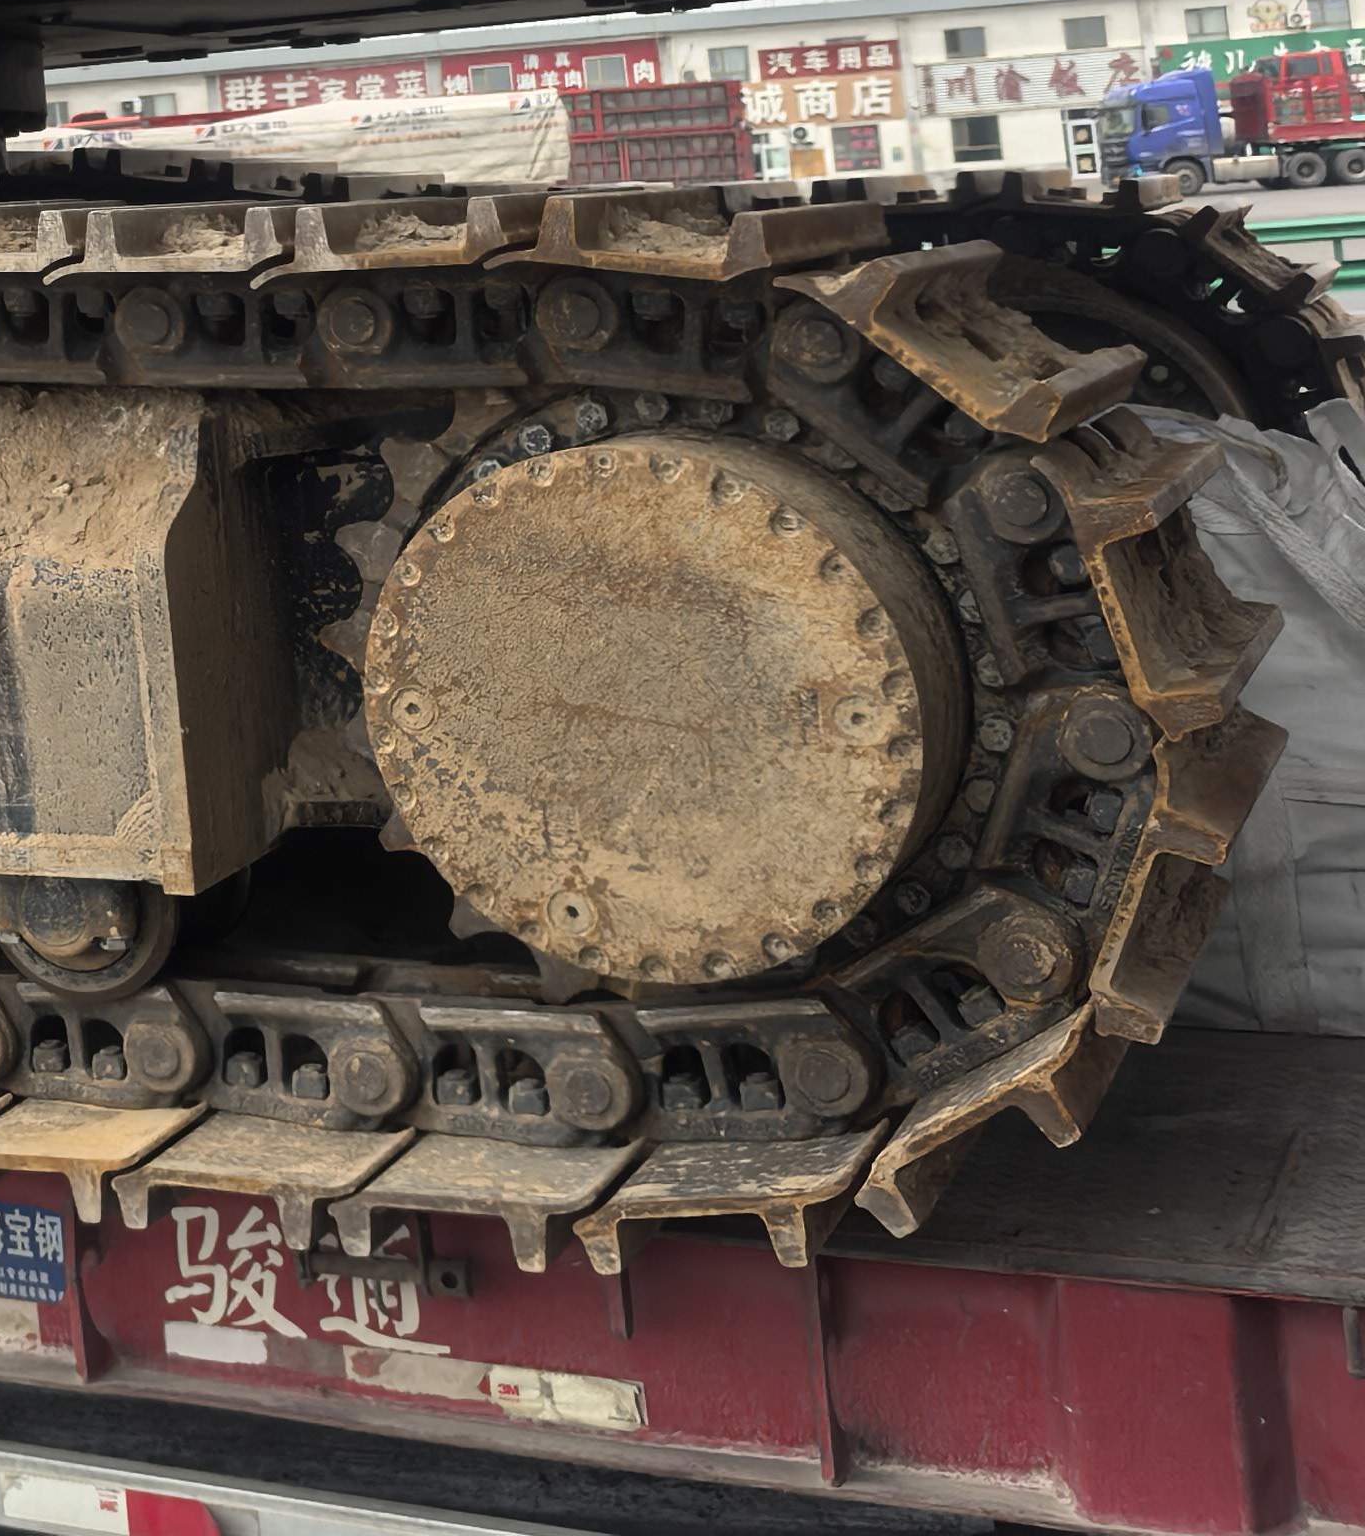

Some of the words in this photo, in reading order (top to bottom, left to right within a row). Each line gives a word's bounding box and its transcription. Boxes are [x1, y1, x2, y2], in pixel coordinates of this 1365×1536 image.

[767, 44, 894, 75] 汽车用品
[740, 76, 894, 124] 诚商店
[164, 1204, 451, 1355] 骏通
[497, 1383, 519, 1396] 3M
